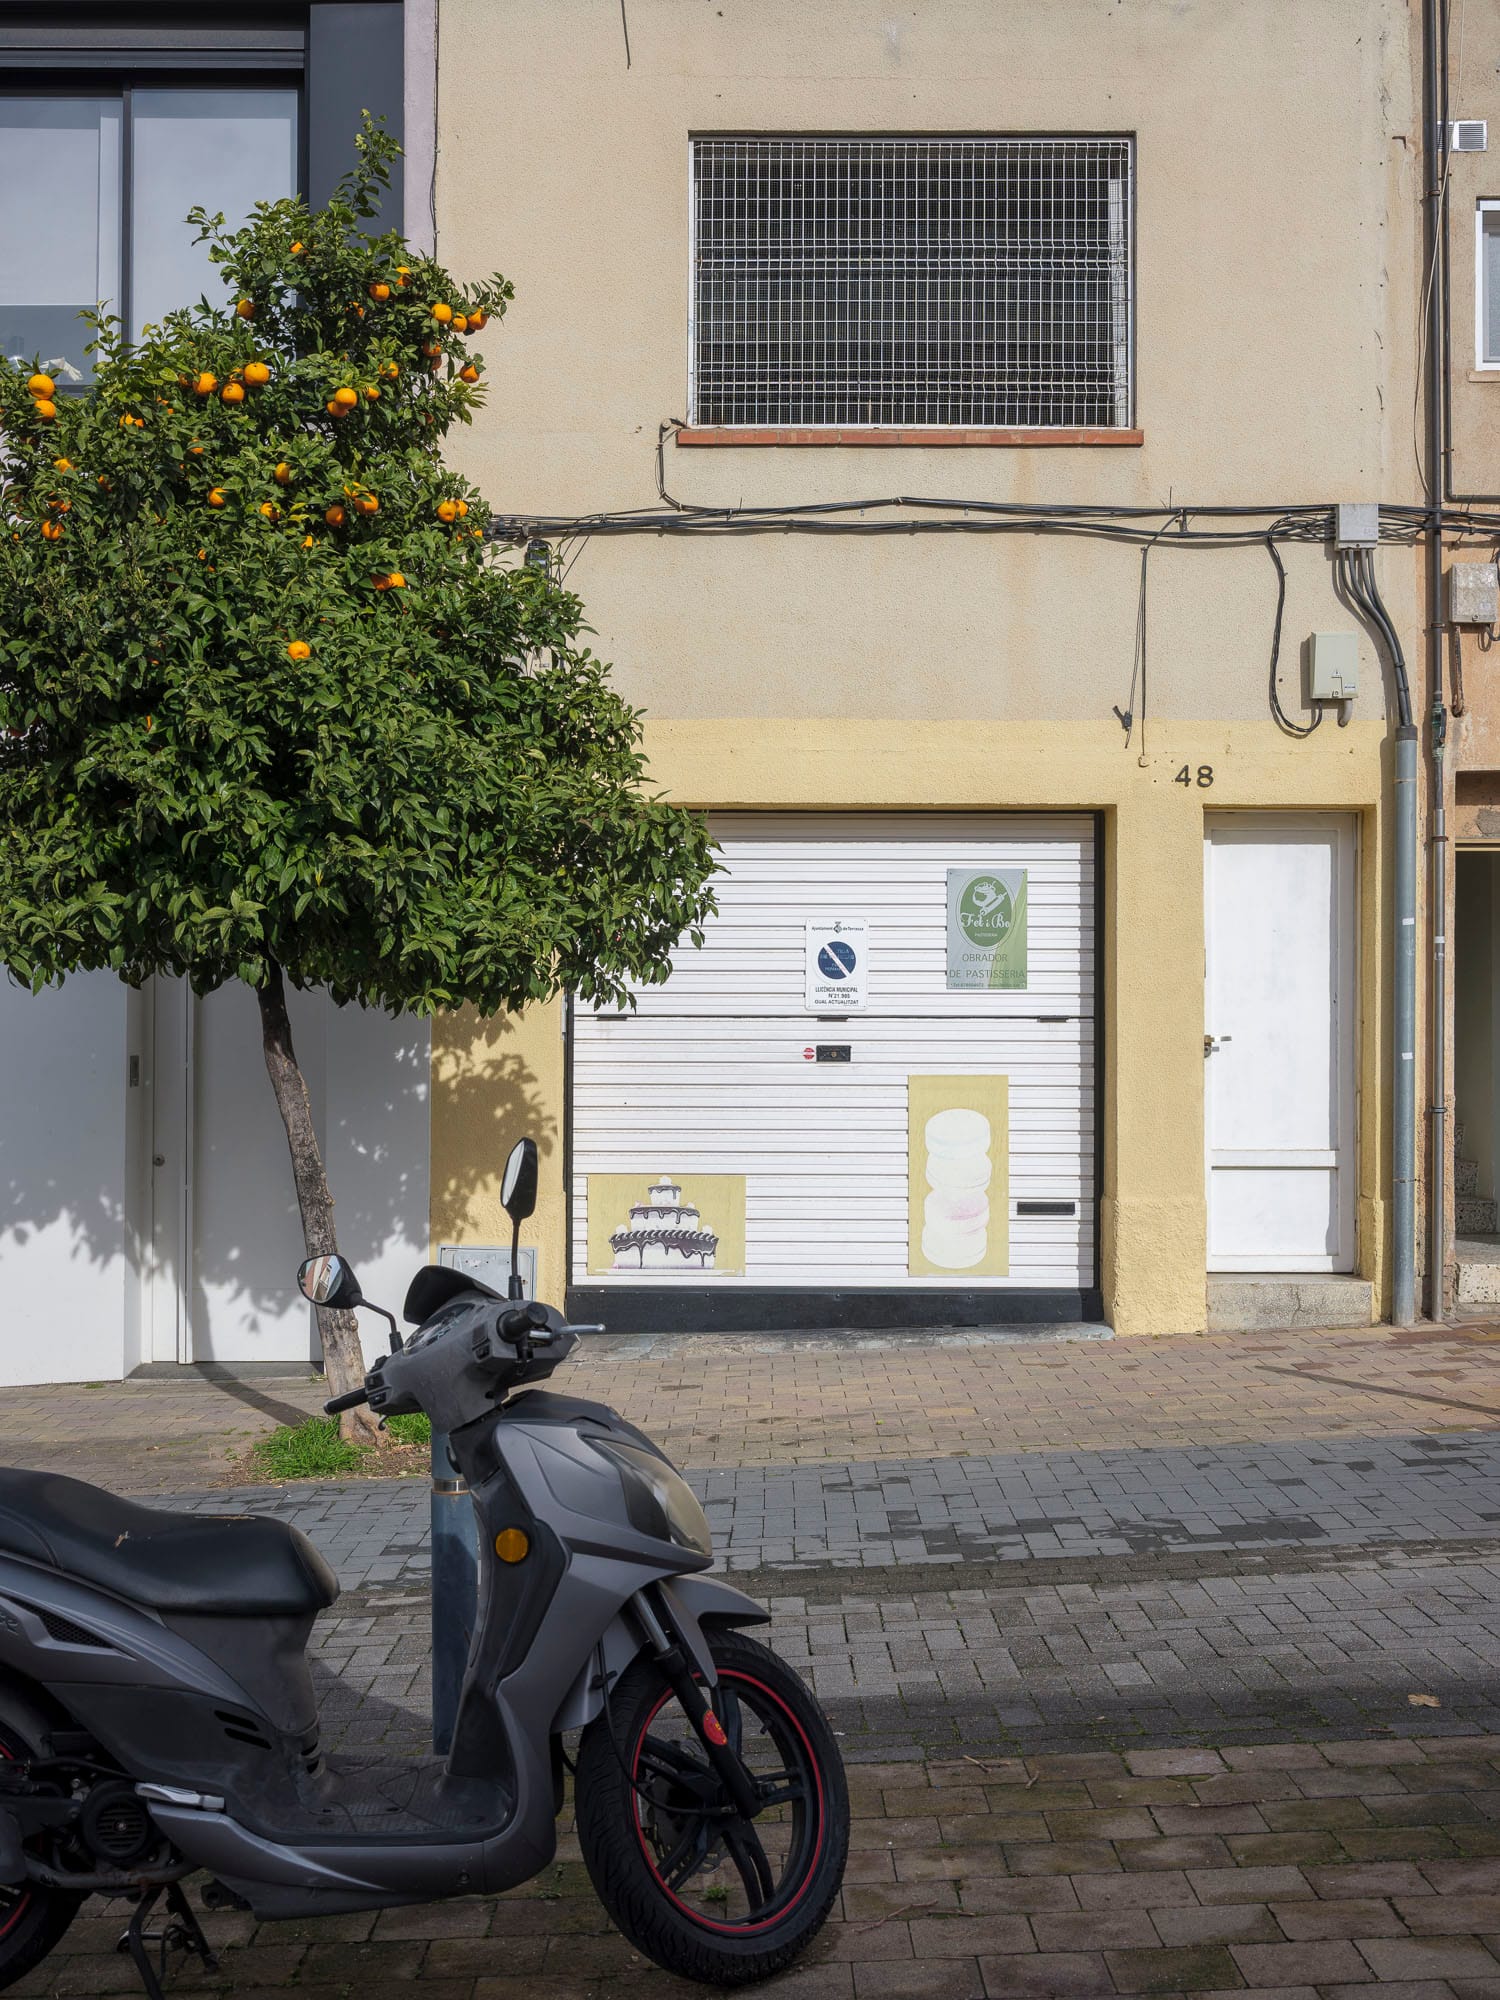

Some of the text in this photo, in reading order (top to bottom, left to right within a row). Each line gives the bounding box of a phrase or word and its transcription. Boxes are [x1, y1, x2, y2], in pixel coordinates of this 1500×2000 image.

[1175, 764, 1214, 788] 48
[962, 953, 1008, 962] OBRADOR
[950, 969, 1025, 979] DE PASTISSERIA
